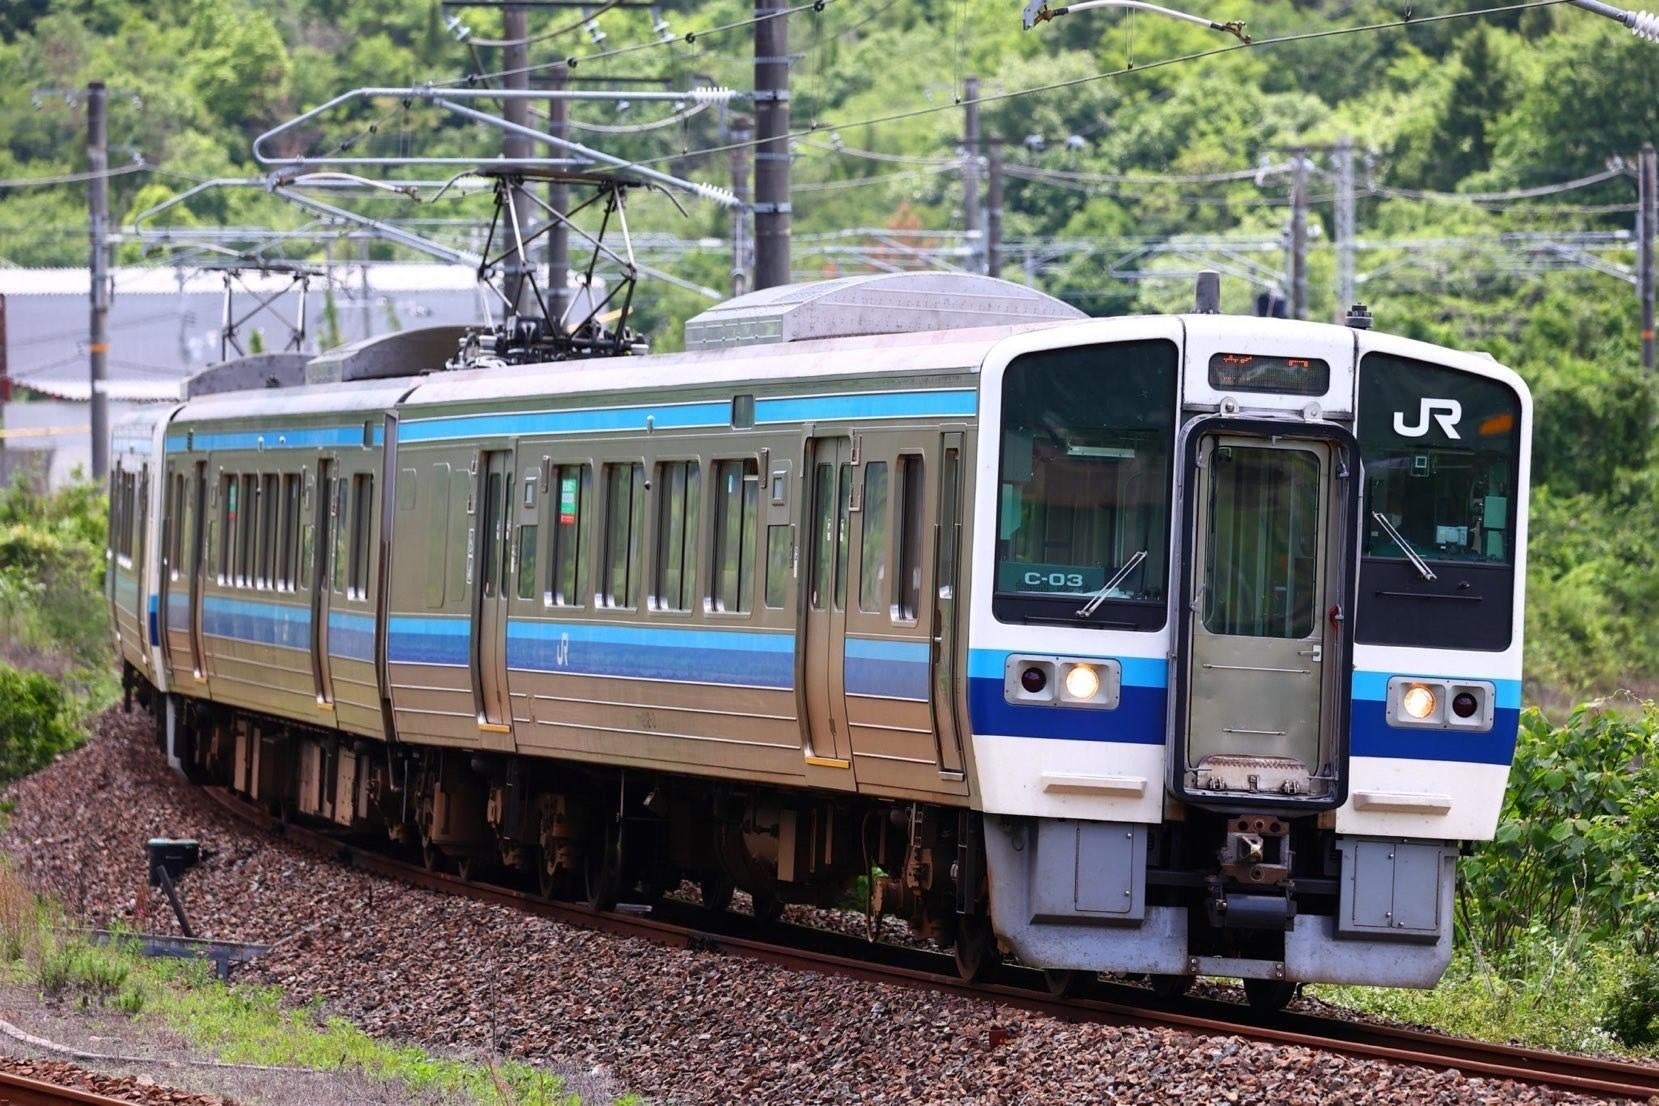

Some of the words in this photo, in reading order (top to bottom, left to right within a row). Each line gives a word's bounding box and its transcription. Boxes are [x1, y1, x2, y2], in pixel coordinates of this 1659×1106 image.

[1393, 397, 1462, 439] JR
[1024, 572, 1083, 587] C-03
[556, 631, 569, 666] JR
